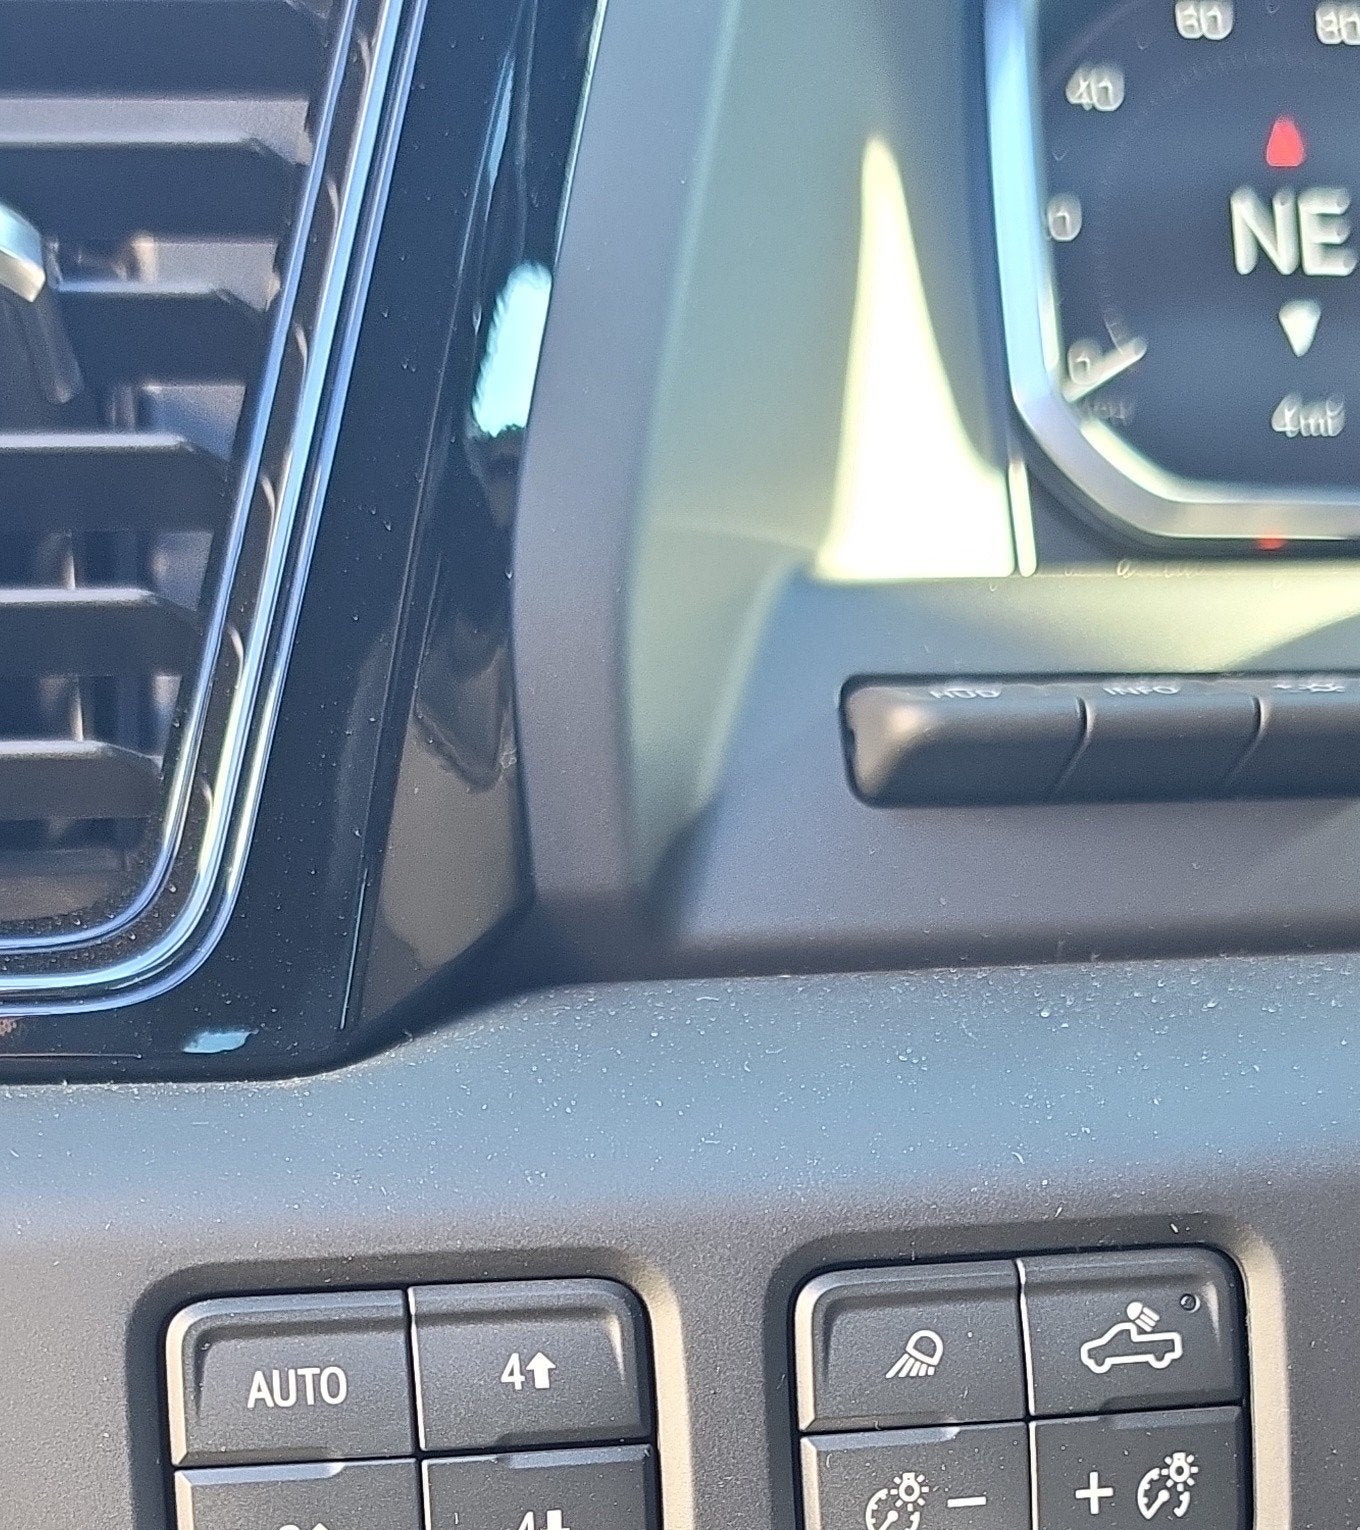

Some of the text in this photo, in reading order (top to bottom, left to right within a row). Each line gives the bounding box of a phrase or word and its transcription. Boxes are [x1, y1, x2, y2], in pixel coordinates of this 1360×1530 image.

[1175, 0, 1234, 40] 60
[1066, 62, 1126, 112] 40
[1230, 184, 1358, 276] NE
[246, 1366, 348, 1409] AUTO
[500, 1353, 525, 1392] 4
